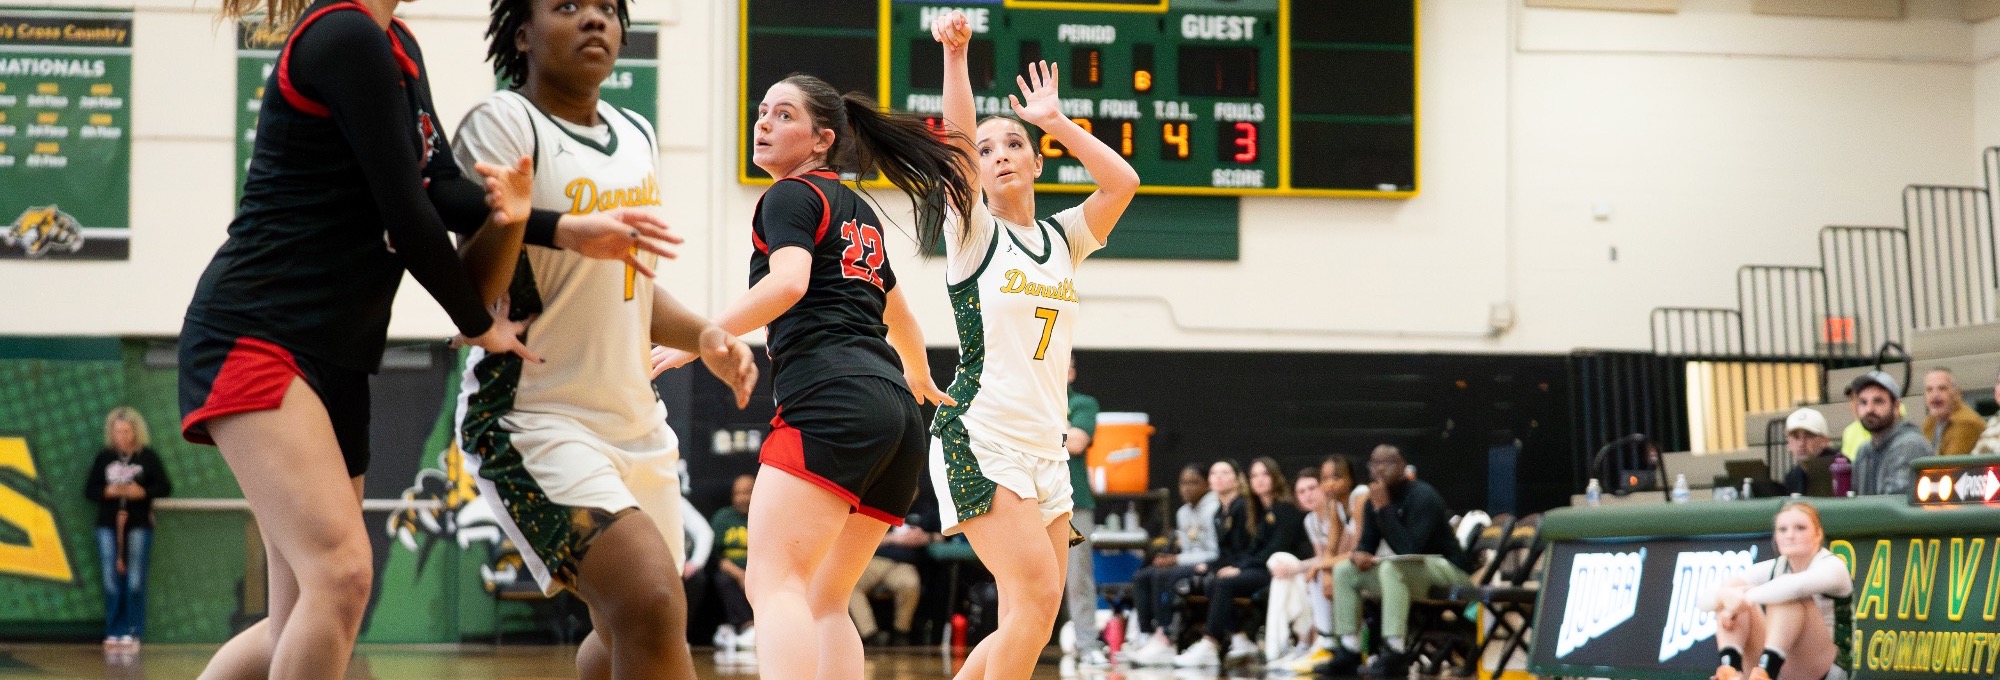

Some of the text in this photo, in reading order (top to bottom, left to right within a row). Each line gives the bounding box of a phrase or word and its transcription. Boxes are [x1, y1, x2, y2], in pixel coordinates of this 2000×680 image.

[17, 23, 61, 41] Cross
[63, 24, 126, 44] Country
[1057, 24, 1115, 44] PERIOD
[1181, 14, 1257, 40] GUEST
[1214, 102, 1264, 121] FOULS
[1122, 122, 1132, 156] 1
[1163, 123, 1189, 158] 4
[1234, 121, 1257, 163] 3
[1212, 169, 1264, 187] SCORE
[840, 218, 886, 294] 22
[1033, 306, 1059, 361] 7
[1867, 629, 2000, 675] COMMUNITY
